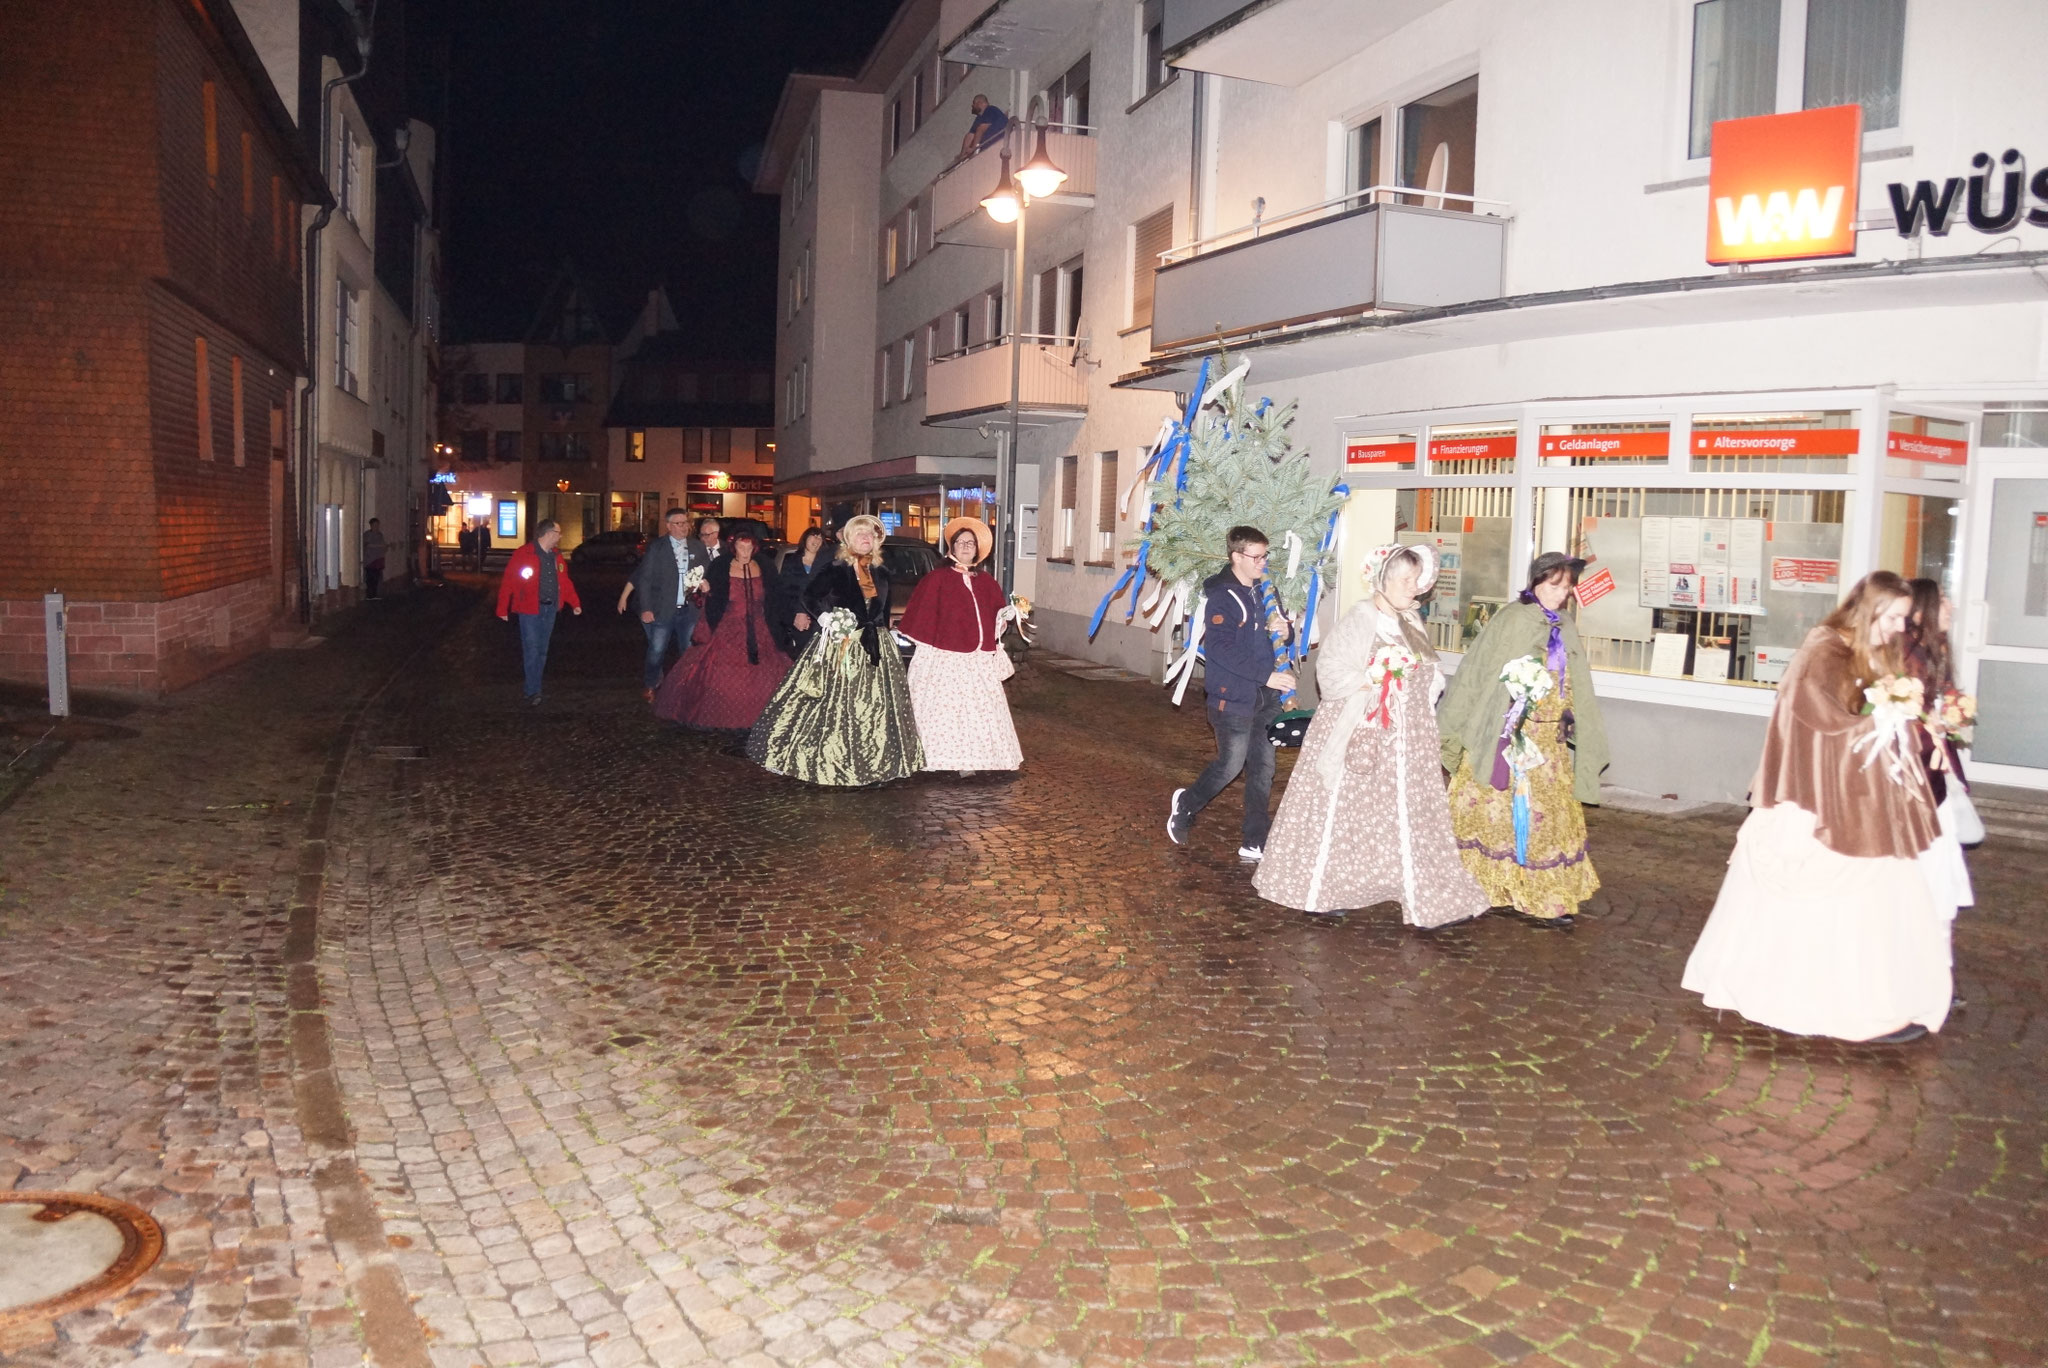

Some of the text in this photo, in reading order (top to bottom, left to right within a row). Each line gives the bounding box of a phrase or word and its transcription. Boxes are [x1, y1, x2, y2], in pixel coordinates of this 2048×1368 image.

[1440, 444, 1488, 455] Finanzierungen
[1559, 438, 1620, 452] Geldanlagen
[1714, 436, 1796, 451] Altersvorsorge
[1899, 439, 1952, 458] Versicherungen
[1357, 449, 1386, 460] Bausparen
